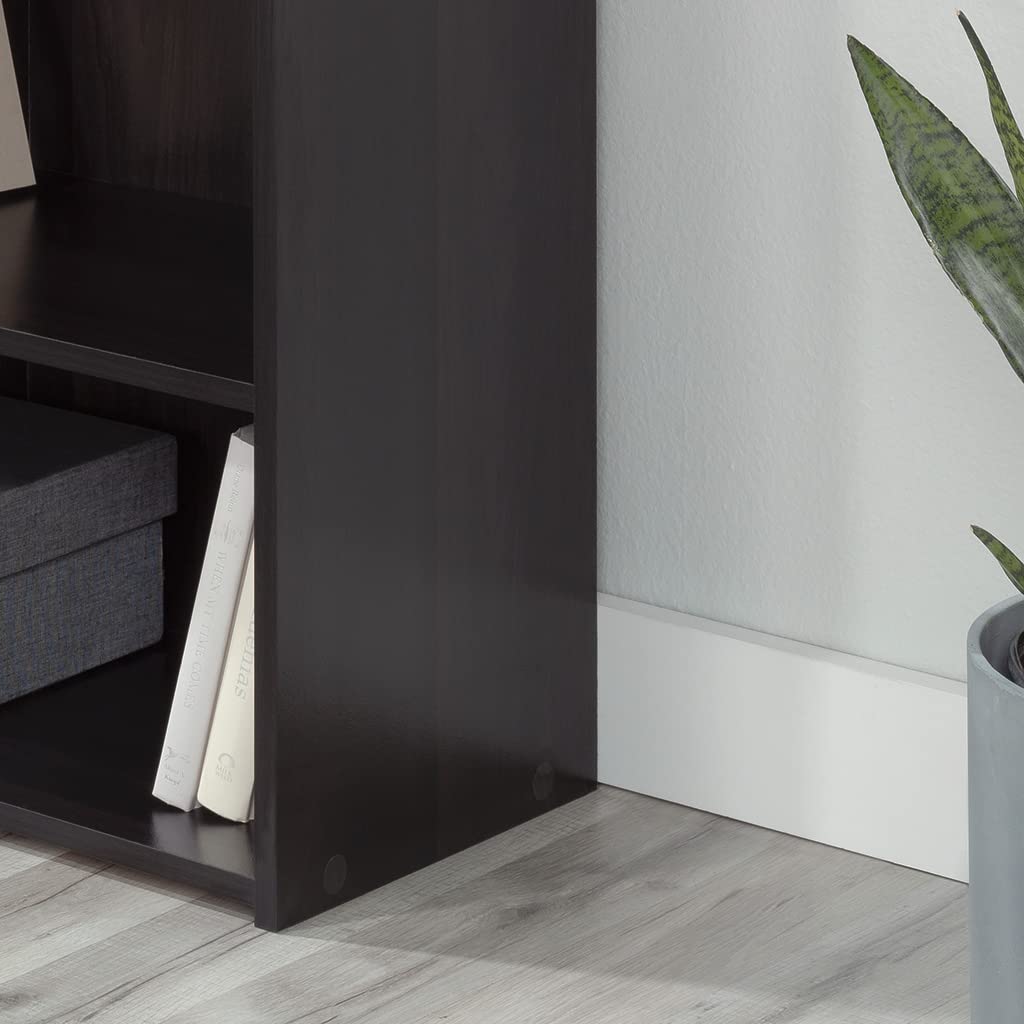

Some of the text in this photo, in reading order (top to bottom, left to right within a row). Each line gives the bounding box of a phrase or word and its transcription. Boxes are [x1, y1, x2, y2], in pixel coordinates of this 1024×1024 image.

[209, 551, 228, 594] WHEN
[194, 624, 211, 657] TIME
[183, 661, 202, 712] COMES
